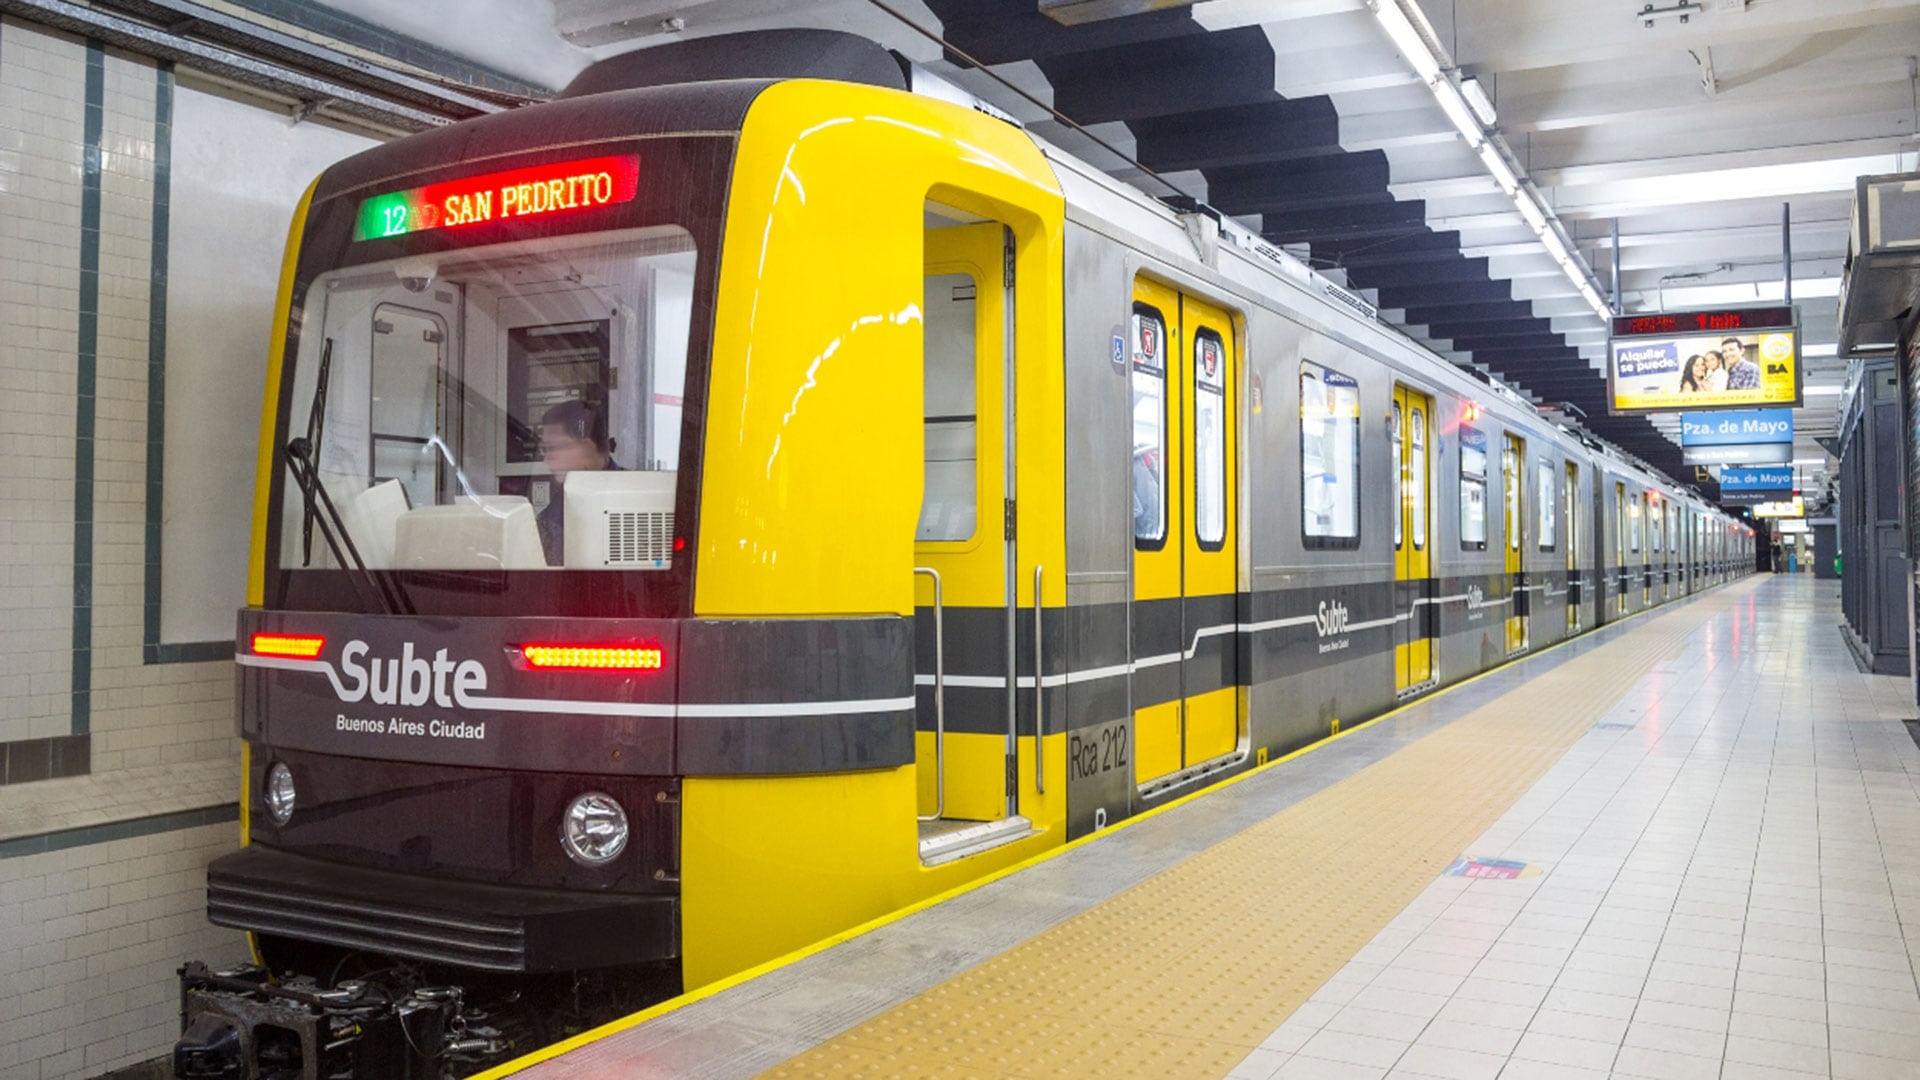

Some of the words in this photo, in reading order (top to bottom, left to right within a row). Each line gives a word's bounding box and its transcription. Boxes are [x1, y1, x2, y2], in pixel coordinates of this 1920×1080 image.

[383, 205, 406, 236] 12
[444, 190, 493, 227] SAN
[501, 171, 612, 218] PEDRITO
[1619, 348, 1667, 363] Alquilar
[1620, 362, 1634, 373] se
[1637, 358, 1678, 375] puede.
[1767, 363, 1788, 374] BA
[1683, 422, 1715, 435] Pza.
[1718, 420, 1739, 434] de
[1743, 420, 1789, 436] Mayo
[1721, 475, 1742, 484] Pza.
[1744, 473, 1758, 483] de
[1760, 473, 1791, 485] Mayo
[1318, 599, 1349, 637] Subte
[340, 639, 488, 711] Subte
[336, 714, 385, 733] Buenos
[388, 717, 425, 736] Aires
[429, 719, 486, 740] Ciudad
[1070, 735, 1098, 781] Rca
[1102, 724, 1127, 772] 212
